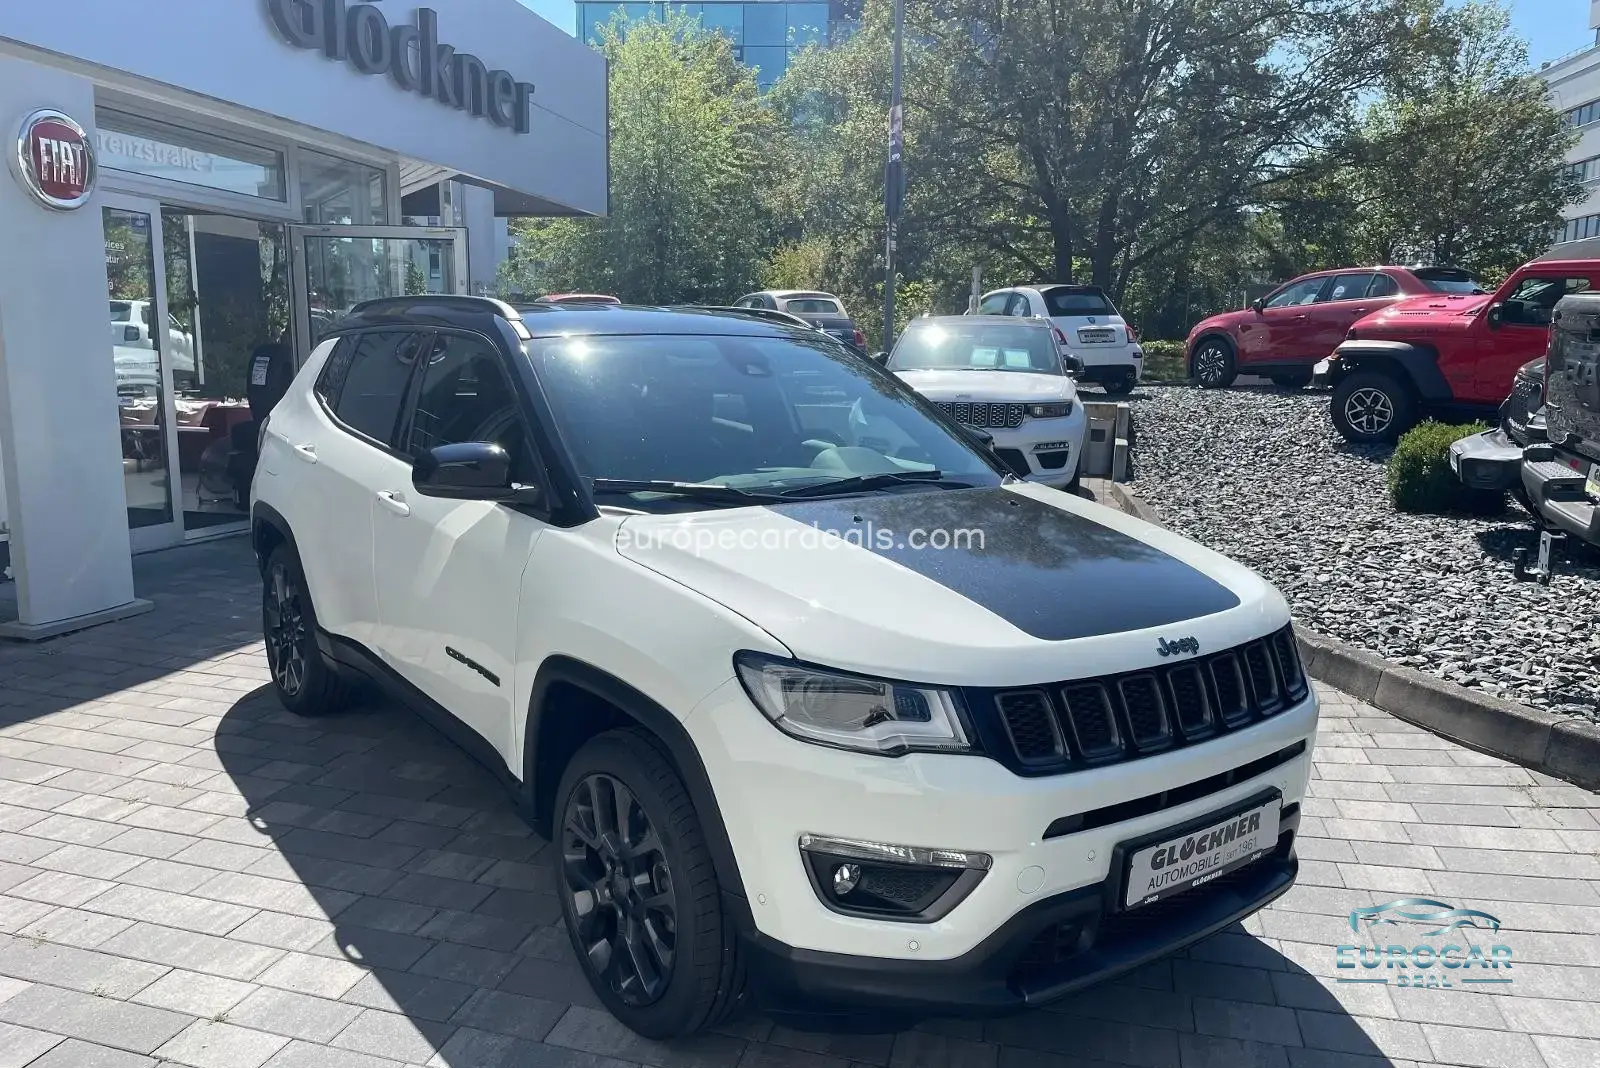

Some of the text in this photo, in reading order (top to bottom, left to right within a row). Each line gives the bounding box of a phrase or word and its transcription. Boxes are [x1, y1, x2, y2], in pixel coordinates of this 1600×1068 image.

[39, 137, 83, 185] FIAT
[1564, 358, 1600, 388] RA
[1157, 636, 1199, 657] Jeep
[1147, 852, 1221, 891] AUTOMOBILE
